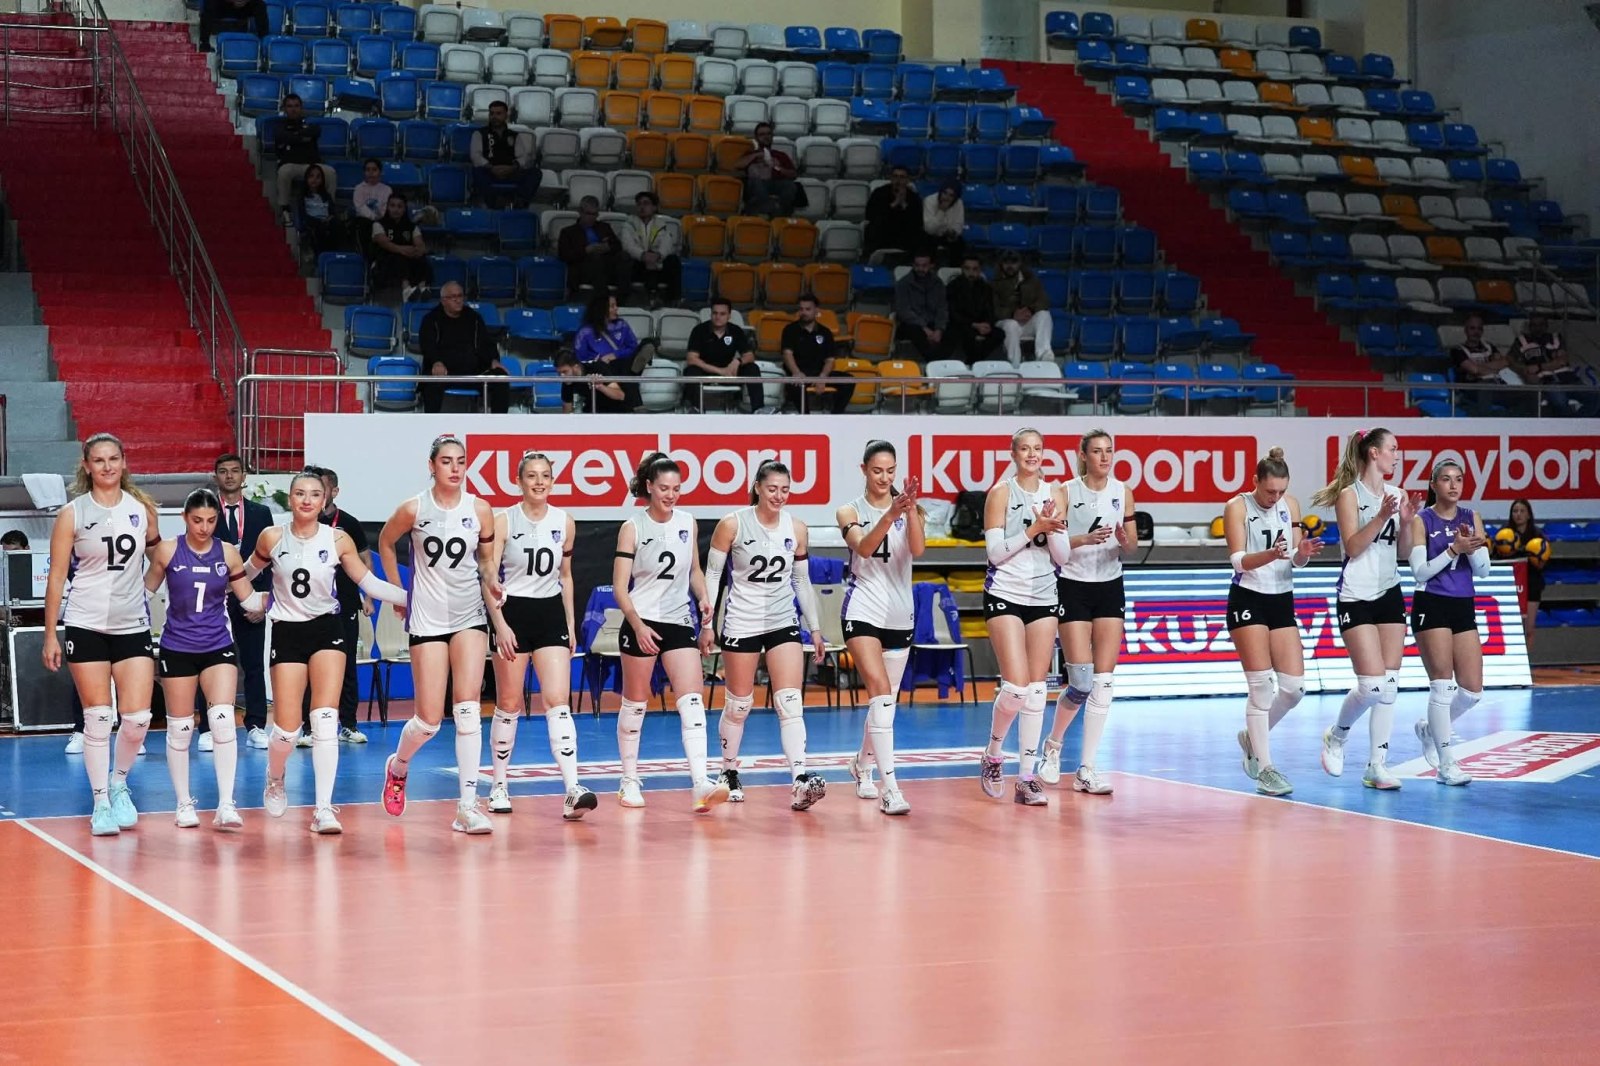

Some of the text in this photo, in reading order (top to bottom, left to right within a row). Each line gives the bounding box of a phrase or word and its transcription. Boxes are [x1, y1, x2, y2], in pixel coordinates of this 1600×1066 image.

[102, 534, 137, 571] 19
[423, 536, 467, 568] 99
[871, 534, 890, 563] 4
[524, 547, 554, 577] 10
[656, 551, 676, 579] 2
[748, 555, 786, 582] 22
[291, 568, 311, 598] 8
[194, 582, 206, 612] 1
[1058, 604, 1065, 617] 6
[1233, 609, 1251, 623] 16
[1339, 612, 1351, 625] 14
[1418, 613, 1425, 625] 7
[845, 621, 853, 632] 4
[65, 640, 74, 655] 19
[622, 635, 630, 648] 2
[725, 636, 739, 647] 22
[161, 660, 168, 673] 1
